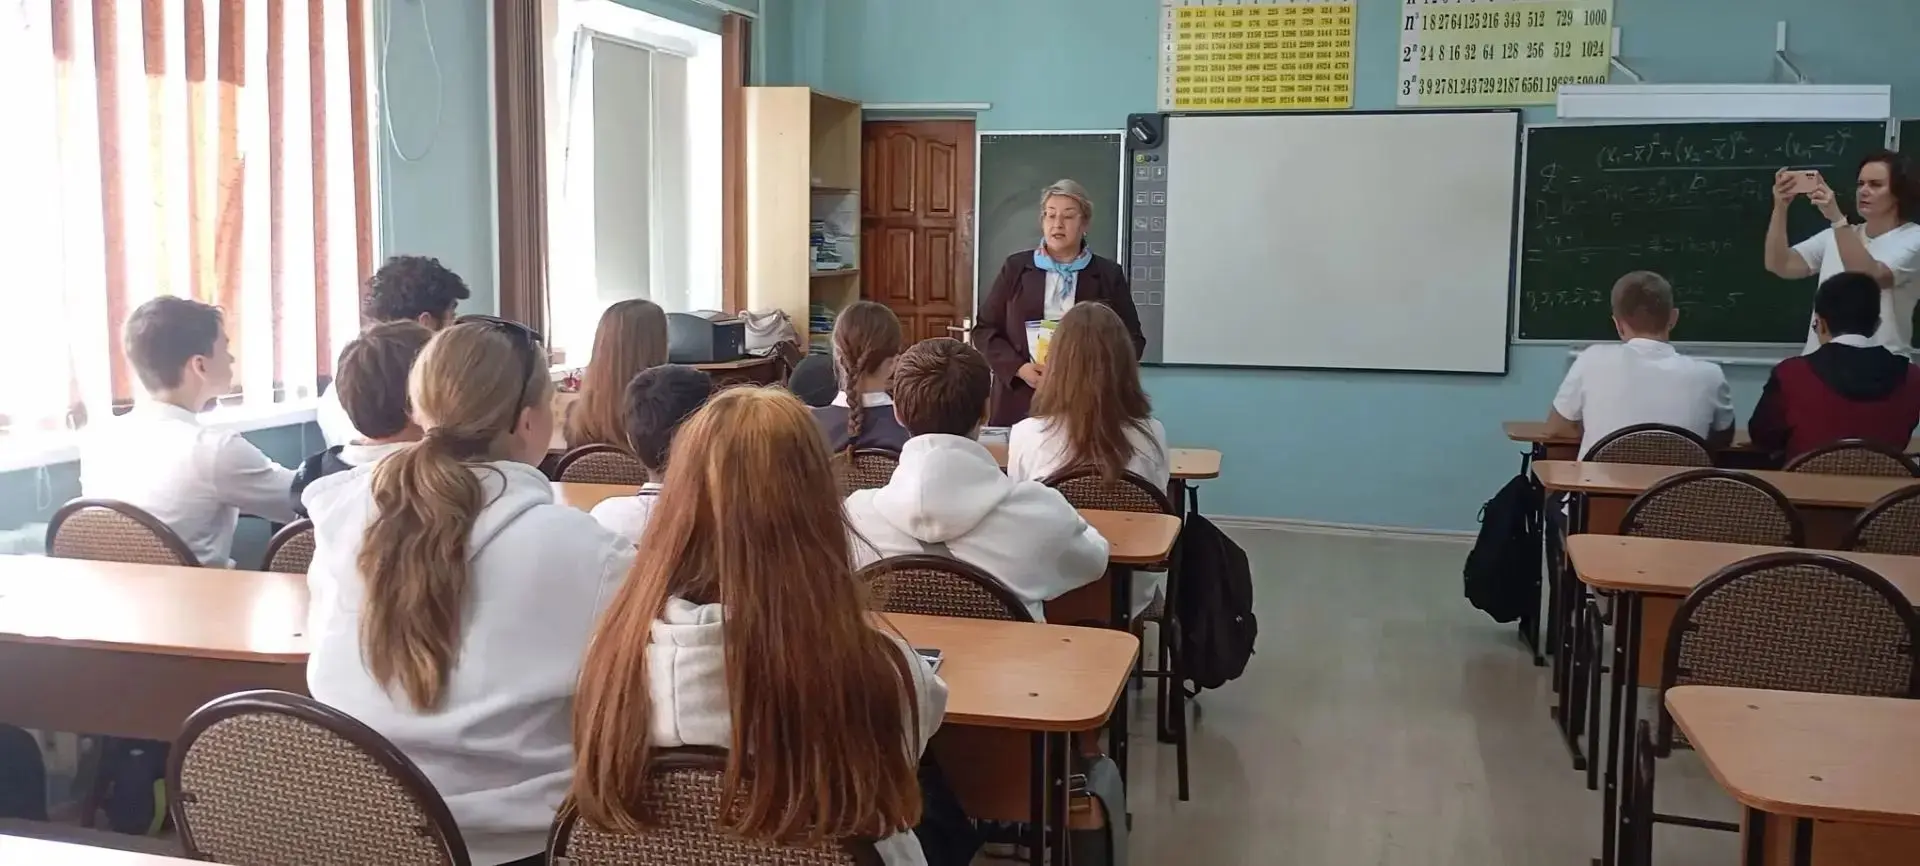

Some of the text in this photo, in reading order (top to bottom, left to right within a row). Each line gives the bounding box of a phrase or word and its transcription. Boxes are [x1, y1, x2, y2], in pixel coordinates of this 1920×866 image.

[1422, 14, 1427, 30] 1
[1430, 13, 1436, 30] 8
[1438, 13, 1449, 30] 27
[1451, 13, 1462, 30] 64
[1464, 13, 1480, 29] 125
[1482, 12, 1499, 29] 216
[1504, 12, 1521, 28] 343
[1528, 11, 1545, 27] 512
[1556, 10, 1573, 26] 729
[1585, 9, 1607, 26] 1000
[1420, 46, 1426, 61] 2
[1428, 46, 1434, 61] 4
[1439, 45, 1445, 61] 8
[1450, 45, 1460, 60] 16
[1465, 44, 1476, 60] 32
[1483, 44, 1494, 60] 64
[1502, 43, 1518, 59] 128
[1527, 43, 1544, 59] 256
[1553, 42, 1571, 58] 512
[1582, 41, 1604, 57] 1024
[1419, 80, 1424, 94] 3
[1427, 80, 1432, 94] 9
[1435, 79, 1446, 94] 27
[1448, 79, 1459, 94] 81
[1460, 78, 1476, 94] 243
[1479, 78, 1495, 94] 729
[1497, 78, 1519, 93] 2187
[1522, 77, 1545, 93] 6561
